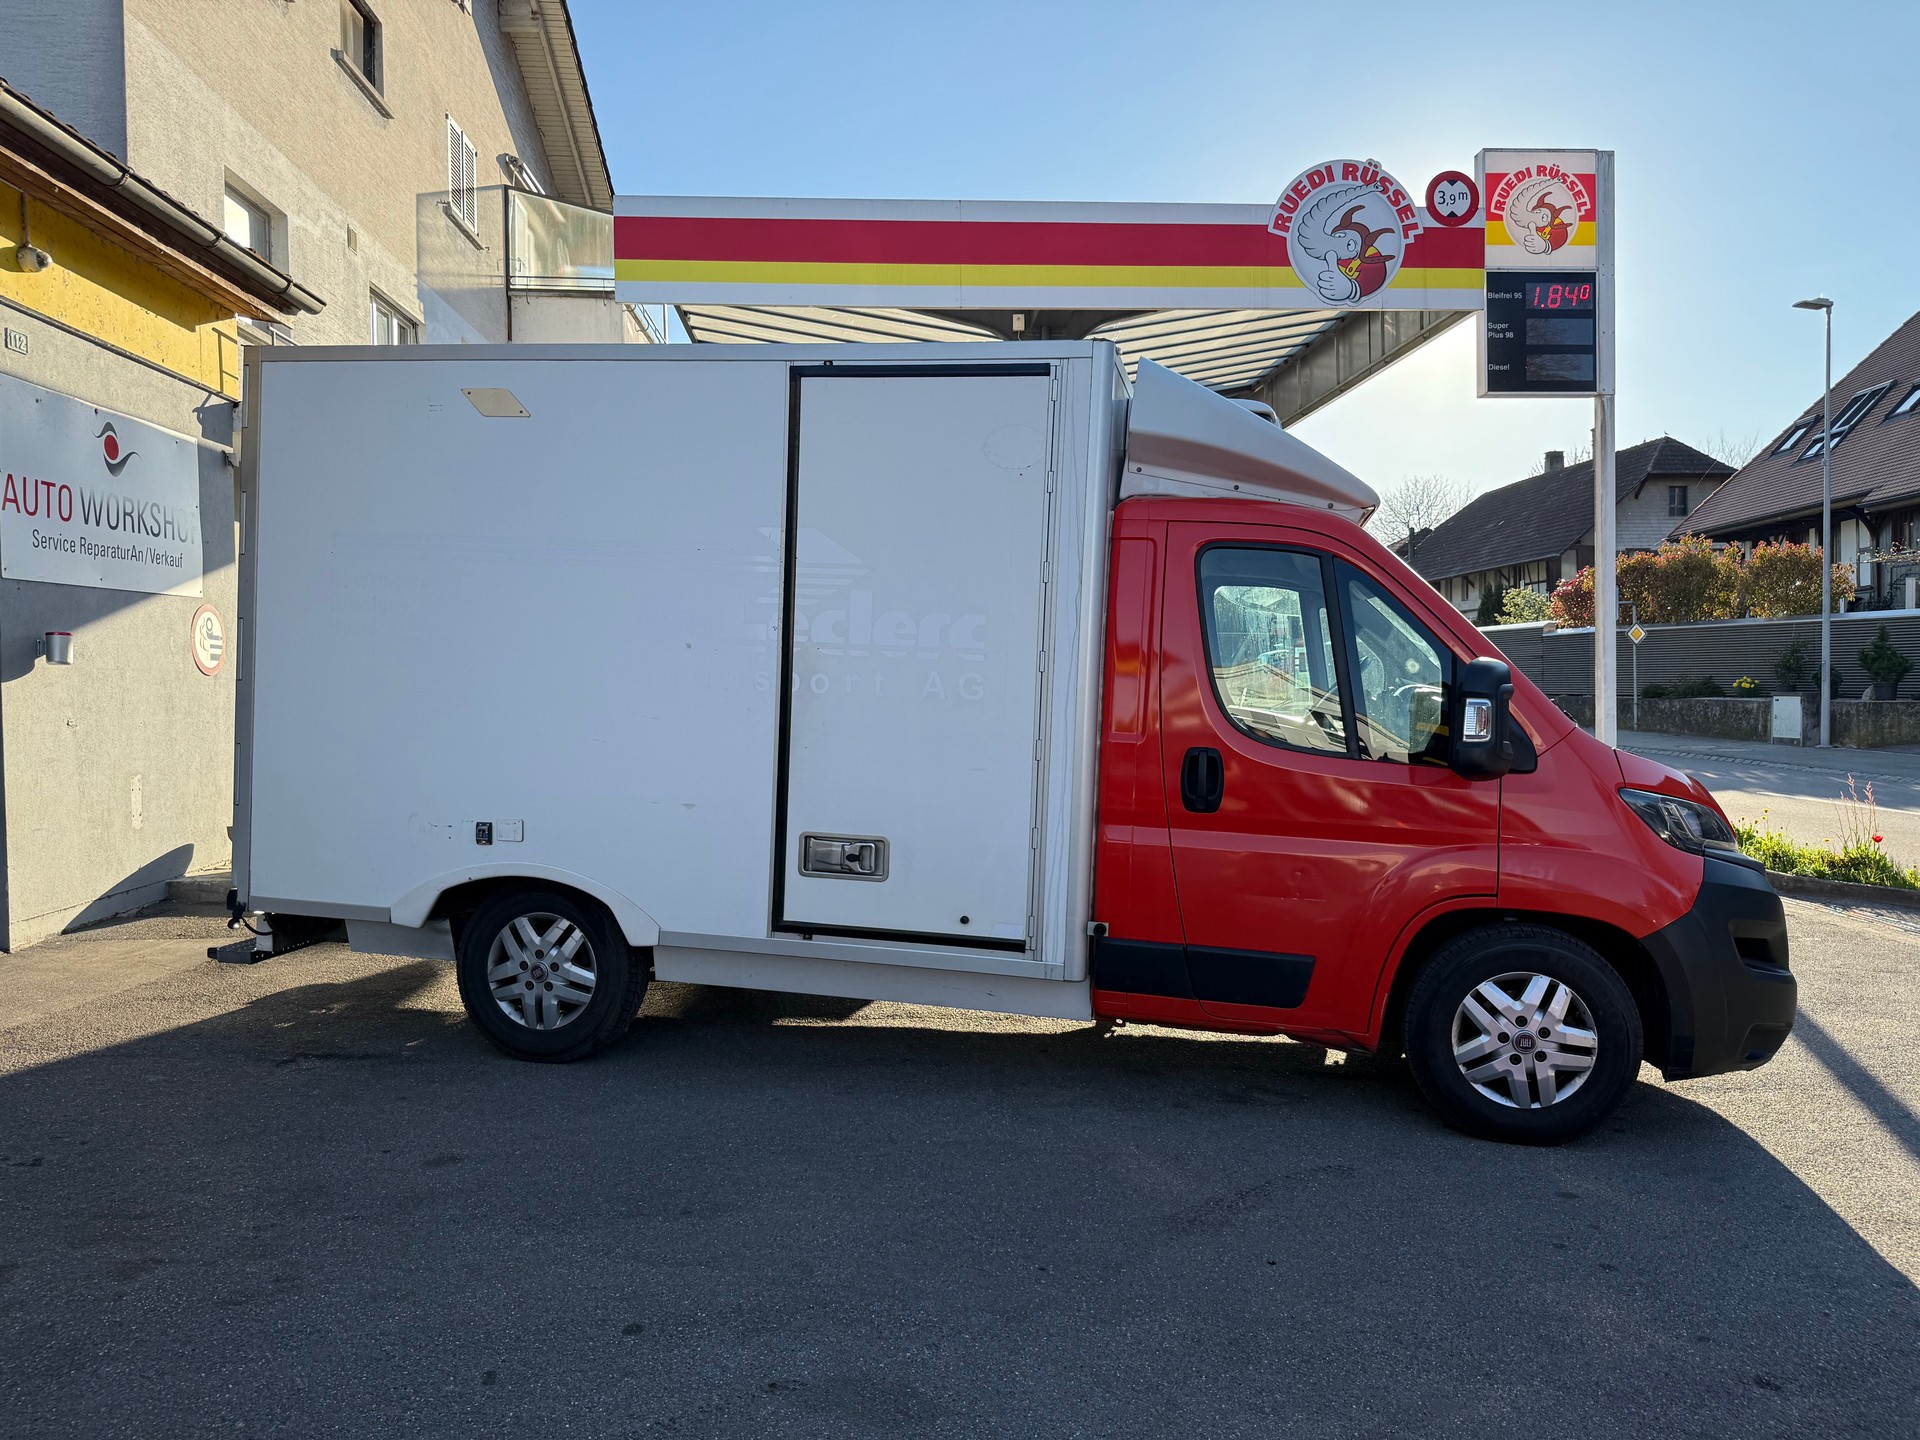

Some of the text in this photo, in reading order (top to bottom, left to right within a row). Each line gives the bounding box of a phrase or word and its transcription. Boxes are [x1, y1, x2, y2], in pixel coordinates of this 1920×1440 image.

[1273, 161, 1419, 240] RUEDI RÜSSEL
[1493, 163, 1588, 213] RUEDI RÜSSEL
[1533, 284, 1591, 309] 1.840
[1487, 322, 1510, 330] Super
[1487, 331, 1514, 339] Plus 98
[9, 331, 26, 352] 112
[1488, 363, 1510, 371] Diesel
[1, 473, 73, 522] AUTO
[32, 529, 76, 554] Service
